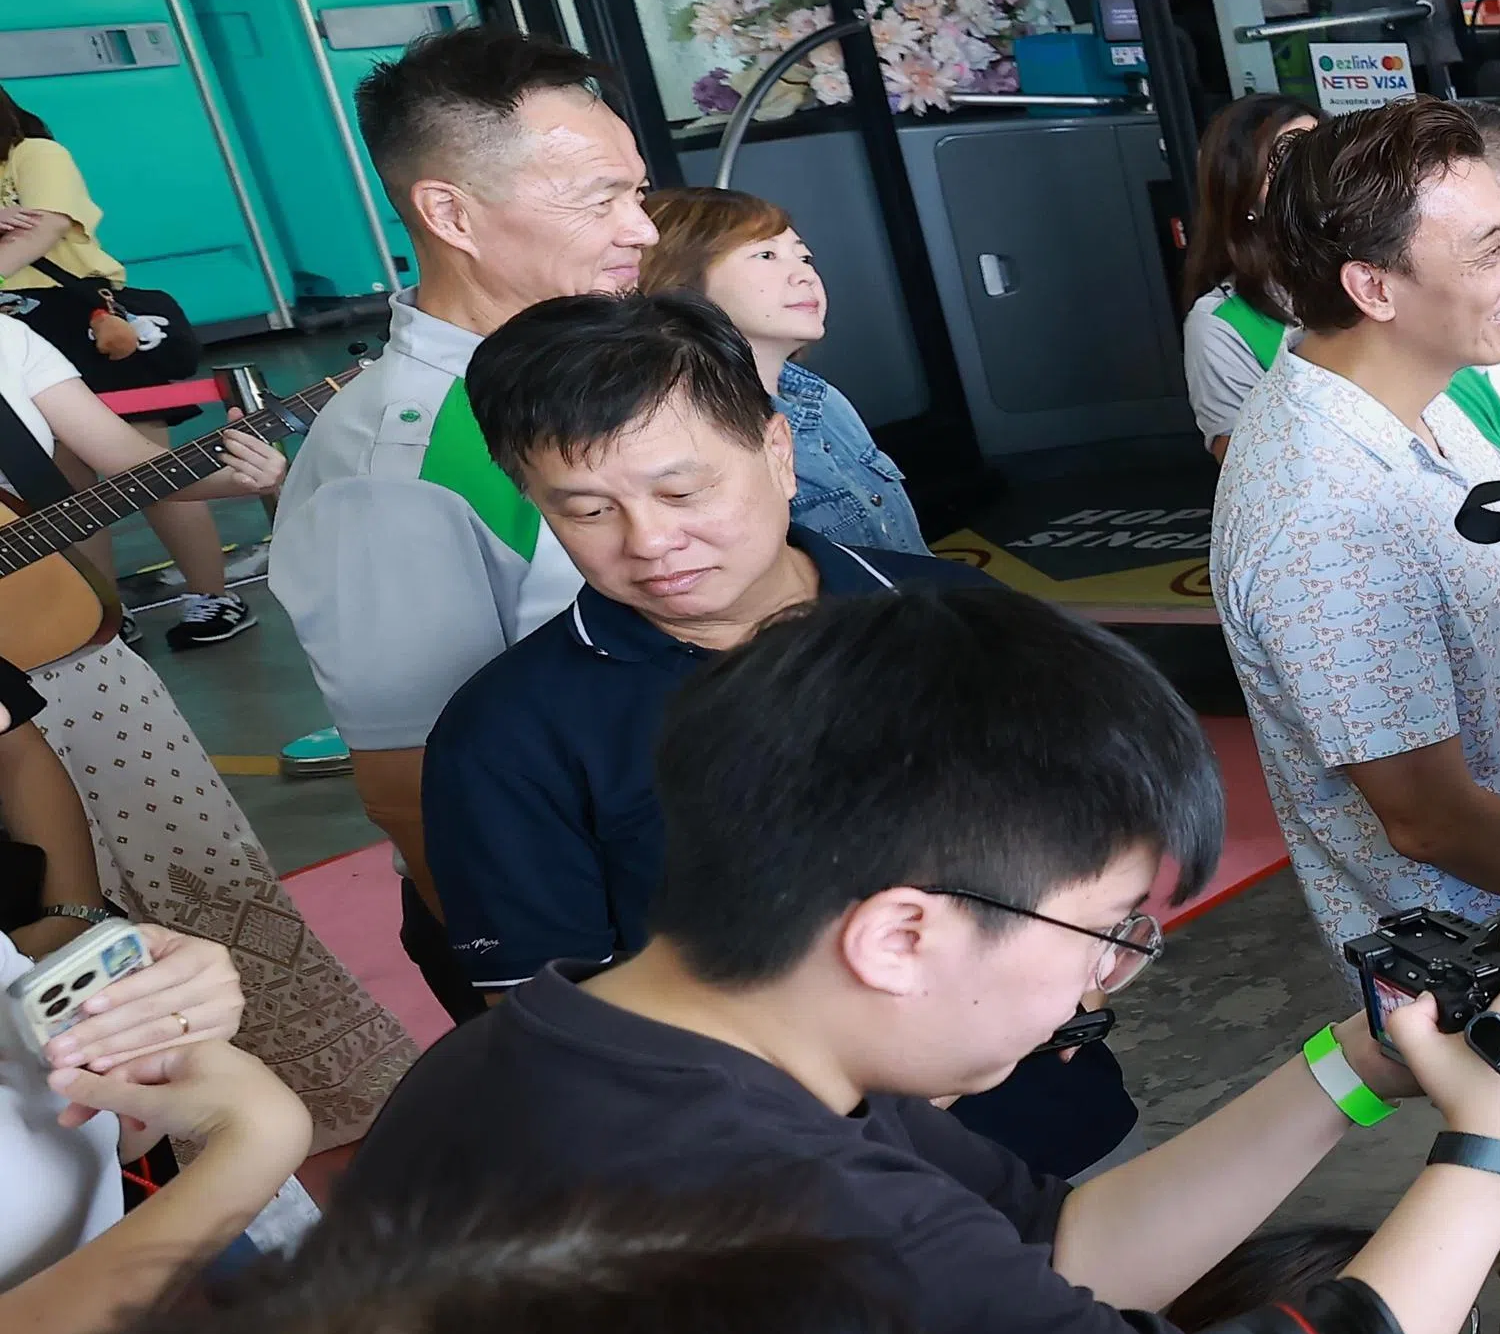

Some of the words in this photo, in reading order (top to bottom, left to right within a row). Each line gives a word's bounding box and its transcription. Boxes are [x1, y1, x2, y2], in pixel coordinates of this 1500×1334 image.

[1336, 55, 1379, 72] ezlink
[1322, 75, 1370, 90] NETS
[1371, 75, 1409, 89] VISA
